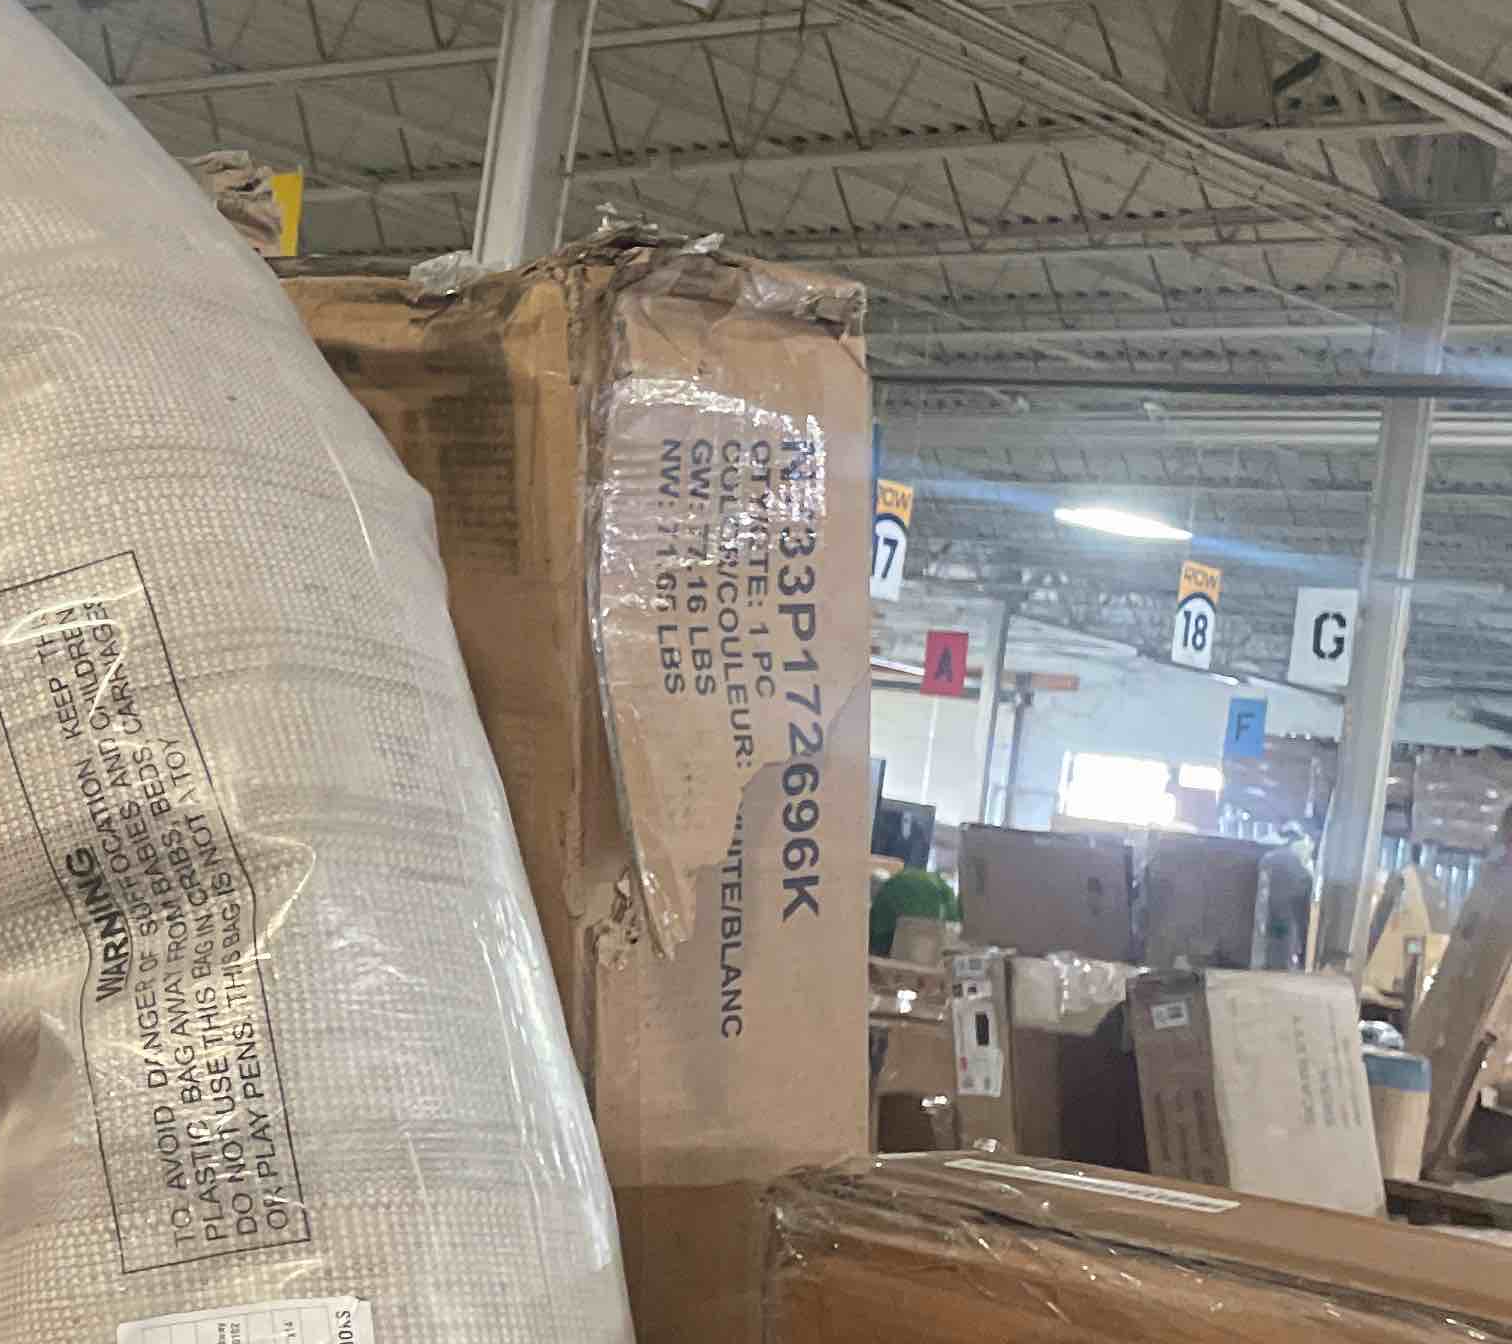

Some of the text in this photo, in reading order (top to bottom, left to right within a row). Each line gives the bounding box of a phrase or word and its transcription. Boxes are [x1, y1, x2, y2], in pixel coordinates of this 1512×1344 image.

[658, 439, 682, 508] NW:
[688, 439, 713, 511] GW:
[658, 624, 686, 695] LBS
[1183, 610, 1208, 651] 18
[1312, 611, 1347, 660] G
[689, 626, 716, 696] LBS
[751, 651, 775, 700] PC
[778, 440, 824, 923] N33P172696K
[935, 645, 954, 683] A
[48, 676, 83, 740] KEEP
[1235, 711, 1256, 741] F
[97, 736, 132, 788] AND
[158, 736, 193, 787] TOY
[75, 756, 159, 938] SUFFOCATION
[120, 799, 172, 897] BABIES
[185, 813, 224, 869] NOT
[212, 871, 236, 897] IS
[66, 847, 129, 1003] WARNING
[161, 897, 188, 964] FROM
[196, 912, 216, 937] IN
[222, 902, 241, 949] BAG
[720, 801, 747, 1039] ITE/BLANC
[139, 951, 159, 975] OF
[191, 938, 215, 980] BAG
[221, 949, 249, 1009] THIS
[192, 985, 224, 1051] THIS
[174, 1044, 202, 1105] BAG
[206, 1055, 236, 1115] USE
[153, 1105, 187, 1190] AVOID
[248, 1107, 279, 1179] PLAY
[186, 1119, 228, 1242] PLASTIC
[171, 1207, 195, 1248] TO
[231, 1191, 258, 1236] DO
